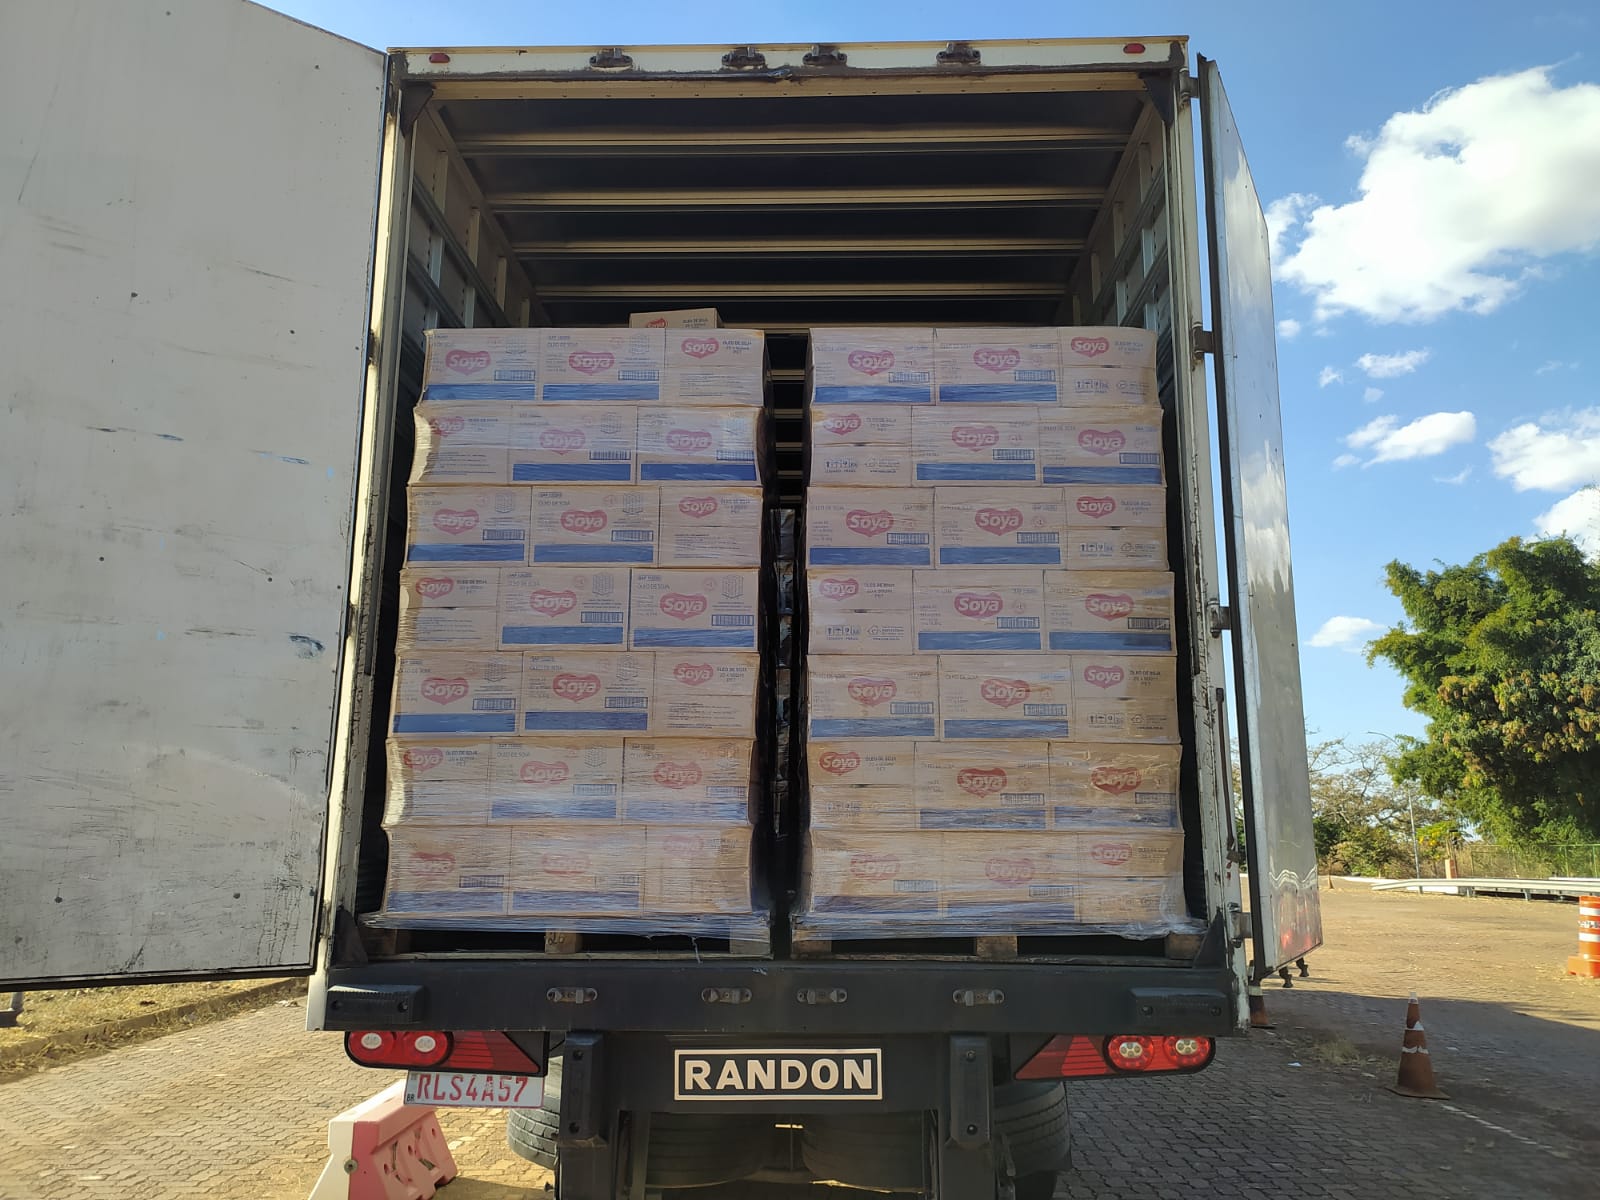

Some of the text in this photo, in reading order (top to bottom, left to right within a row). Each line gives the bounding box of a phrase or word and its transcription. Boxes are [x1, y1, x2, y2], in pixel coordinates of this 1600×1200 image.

[685, 342, 715, 356] Soya
[1073, 340, 1106, 352] Soya
[449, 355, 488, 368] Soya
[572, 355, 610, 369] Soya
[853, 356, 892, 368] Soya
[979, 352, 1018, 368] Soya
[671, 433, 708, 449] Soya
[957, 431, 996, 446] Soya
[1080, 434, 1121, 450] Soya
[683, 501, 714, 513] Soya
[1080, 501, 1113, 513] Soya
[564, 514, 603, 529] Soya
[849, 516, 889, 530] Soya
[979, 514, 1019, 528] Soya
[418, 581, 451, 595] Soya
[822, 583, 856, 596] Soya
[535, 595, 572, 610] Soya
[663, 598, 704, 614] Soya
[958, 598, 999, 613] Soya
[1090, 599, 1130, 615] Soya
[676, 667, 711, 682] Soya
[1087, 670, 1121, 683] Soya
[424, 682, 465, 698] Soya
[557, 680, 597, 695] Soya
[851, 684, 893, 699] Soya
[986, 684, 1025, 700] Soya
[409, 753, 439, 767] Soya
[823, 755, 857, 769] Soya
[525, 766, 565, 781] Soya
[962, 775, 1003, 790] Soya
[684, 1058, 872, 1090] RANDON
[416, 1073, 528, 1103] RLS4A57
